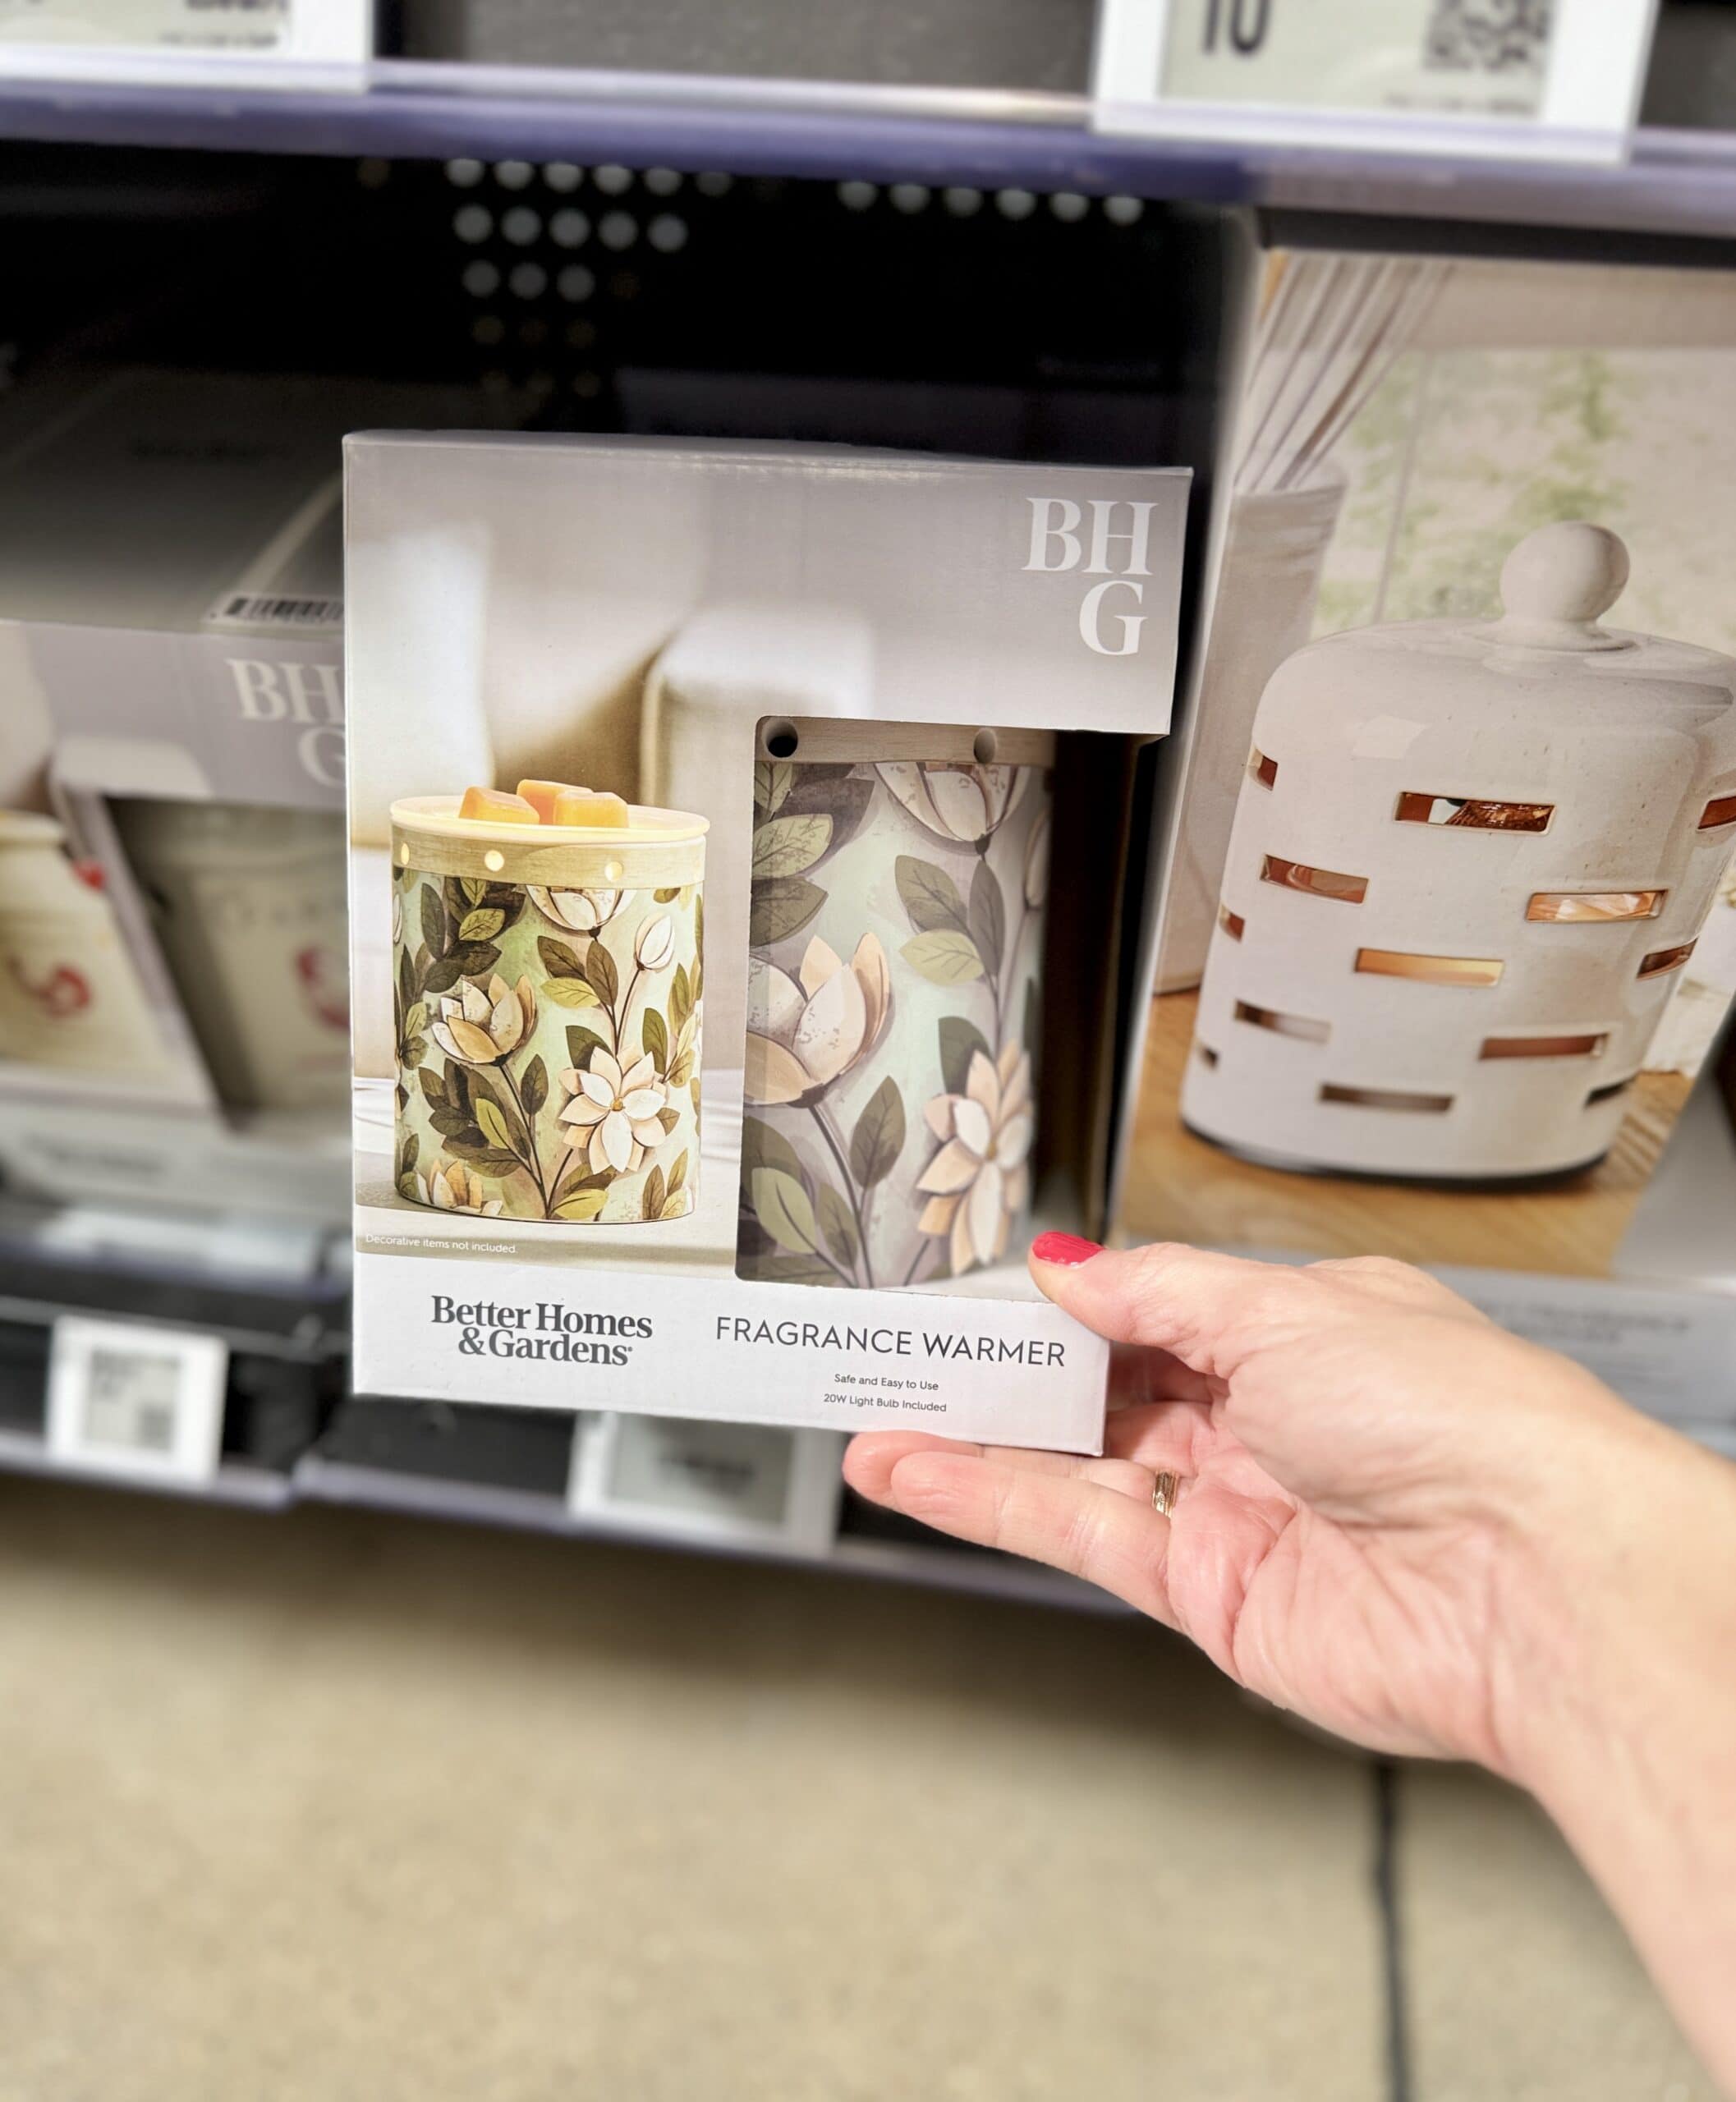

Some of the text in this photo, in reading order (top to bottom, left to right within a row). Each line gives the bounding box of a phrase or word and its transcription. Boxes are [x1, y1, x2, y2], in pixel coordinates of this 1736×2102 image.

[1021, 497, 1160, 576] BH
[1078, 580, 1148, 656] G
[223, 658, 346, 724] BH
[365, 1234, 517, 1254] Decorative items not included.
[431, 1295, 653, 1338] Better Homes
[716, 1316, 1065, 1367] FRAGRANCE WARMER
[824, 1393, 947, 1412] 20W Light Bulb Included
[834, 1374, 939, 1391] Safe and Easy to Use
